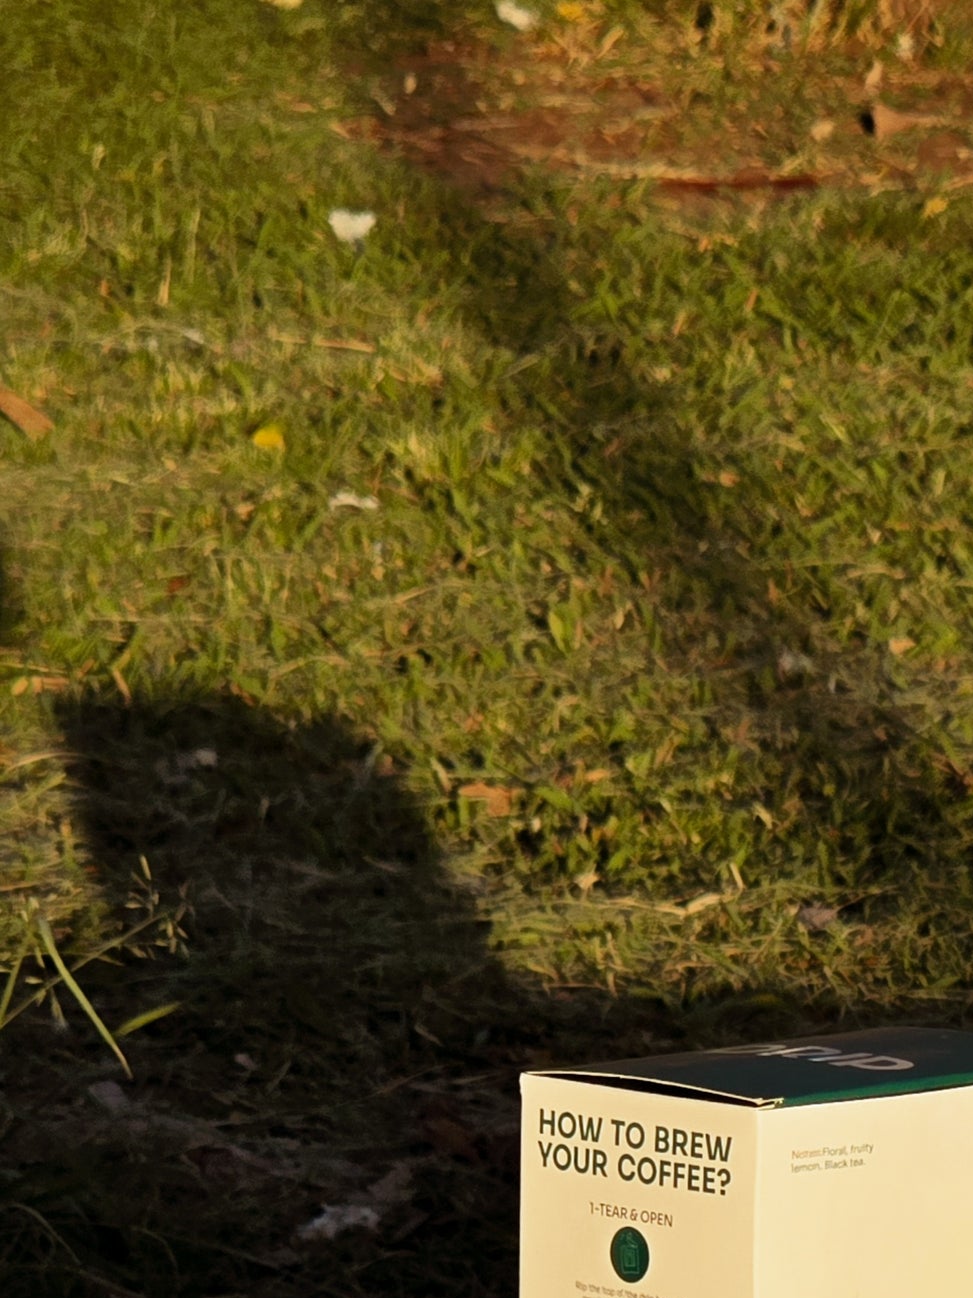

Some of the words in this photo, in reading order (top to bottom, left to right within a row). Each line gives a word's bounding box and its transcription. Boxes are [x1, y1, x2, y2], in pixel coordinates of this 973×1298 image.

[702, 1044, 914, 1071] DRIP
[539, 1108, 603, 1143] HOW
[611, 1119, 645, 1149] TO
[655, 1125, 732, 1162] BREW
[850, 1144, 873, 1154] fruity
[538, 1140, 608, 1178] YOUR
[618, 1153, 731, 1196] COFFEE?
[824, 1159, 848, 1169] Black
[850, 1158, 866, 1167] tea.
[589, 1201, 628, 1219] 1-TEAR
[630, 1208, 640, 1221] &
[640, 1210, 673, 1227] OPEN
[576, 1281, 587, 1291] Rip
[589, 1284, 600, 1293] the
[602, 1287, 614, 1296] top
[617, 1289, 623, 1297] of
